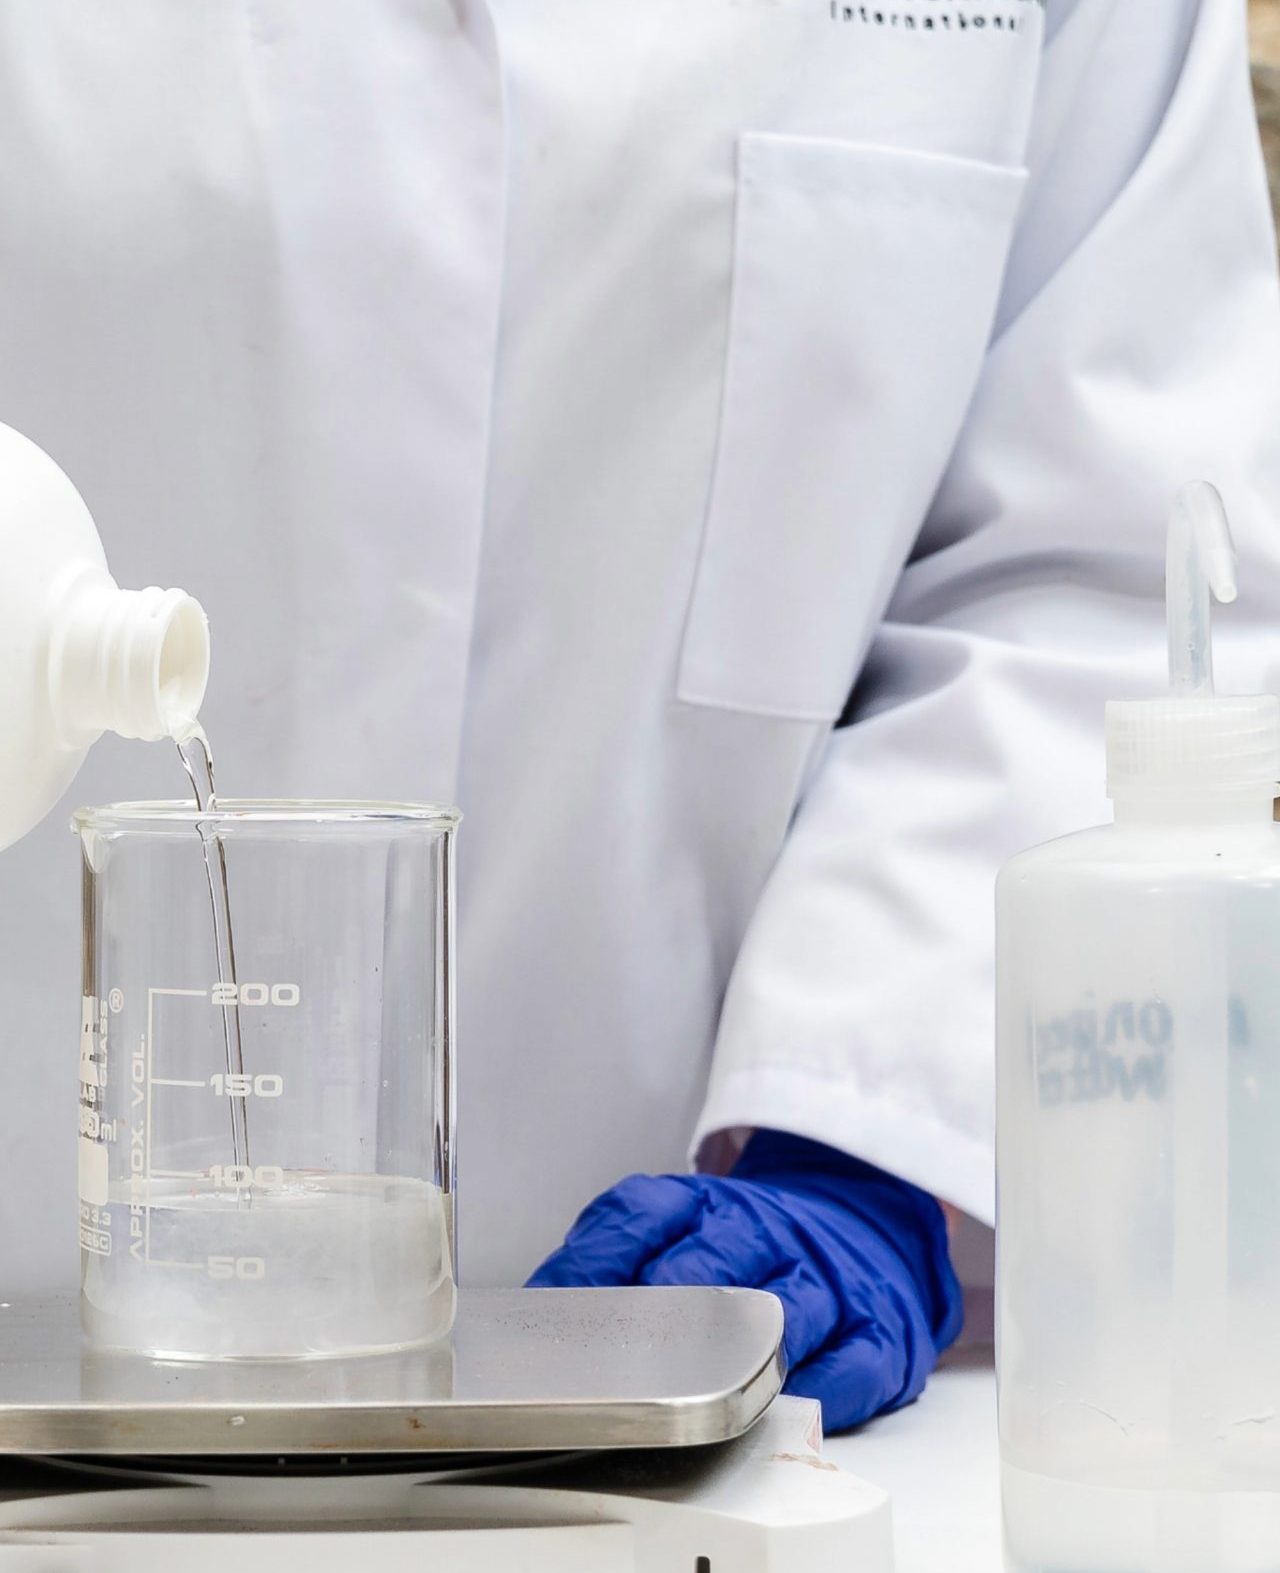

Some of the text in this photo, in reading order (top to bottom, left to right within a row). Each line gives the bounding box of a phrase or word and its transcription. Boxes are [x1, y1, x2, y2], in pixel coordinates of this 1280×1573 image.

[211, 983, 300, 1006] 200
[131, 1034, 145, 1108] VOL.
[210, 1074, 284, 1097] 150
[209, 1165, 284, 1188] 100
[207, 1256, 266, 1279] 50
